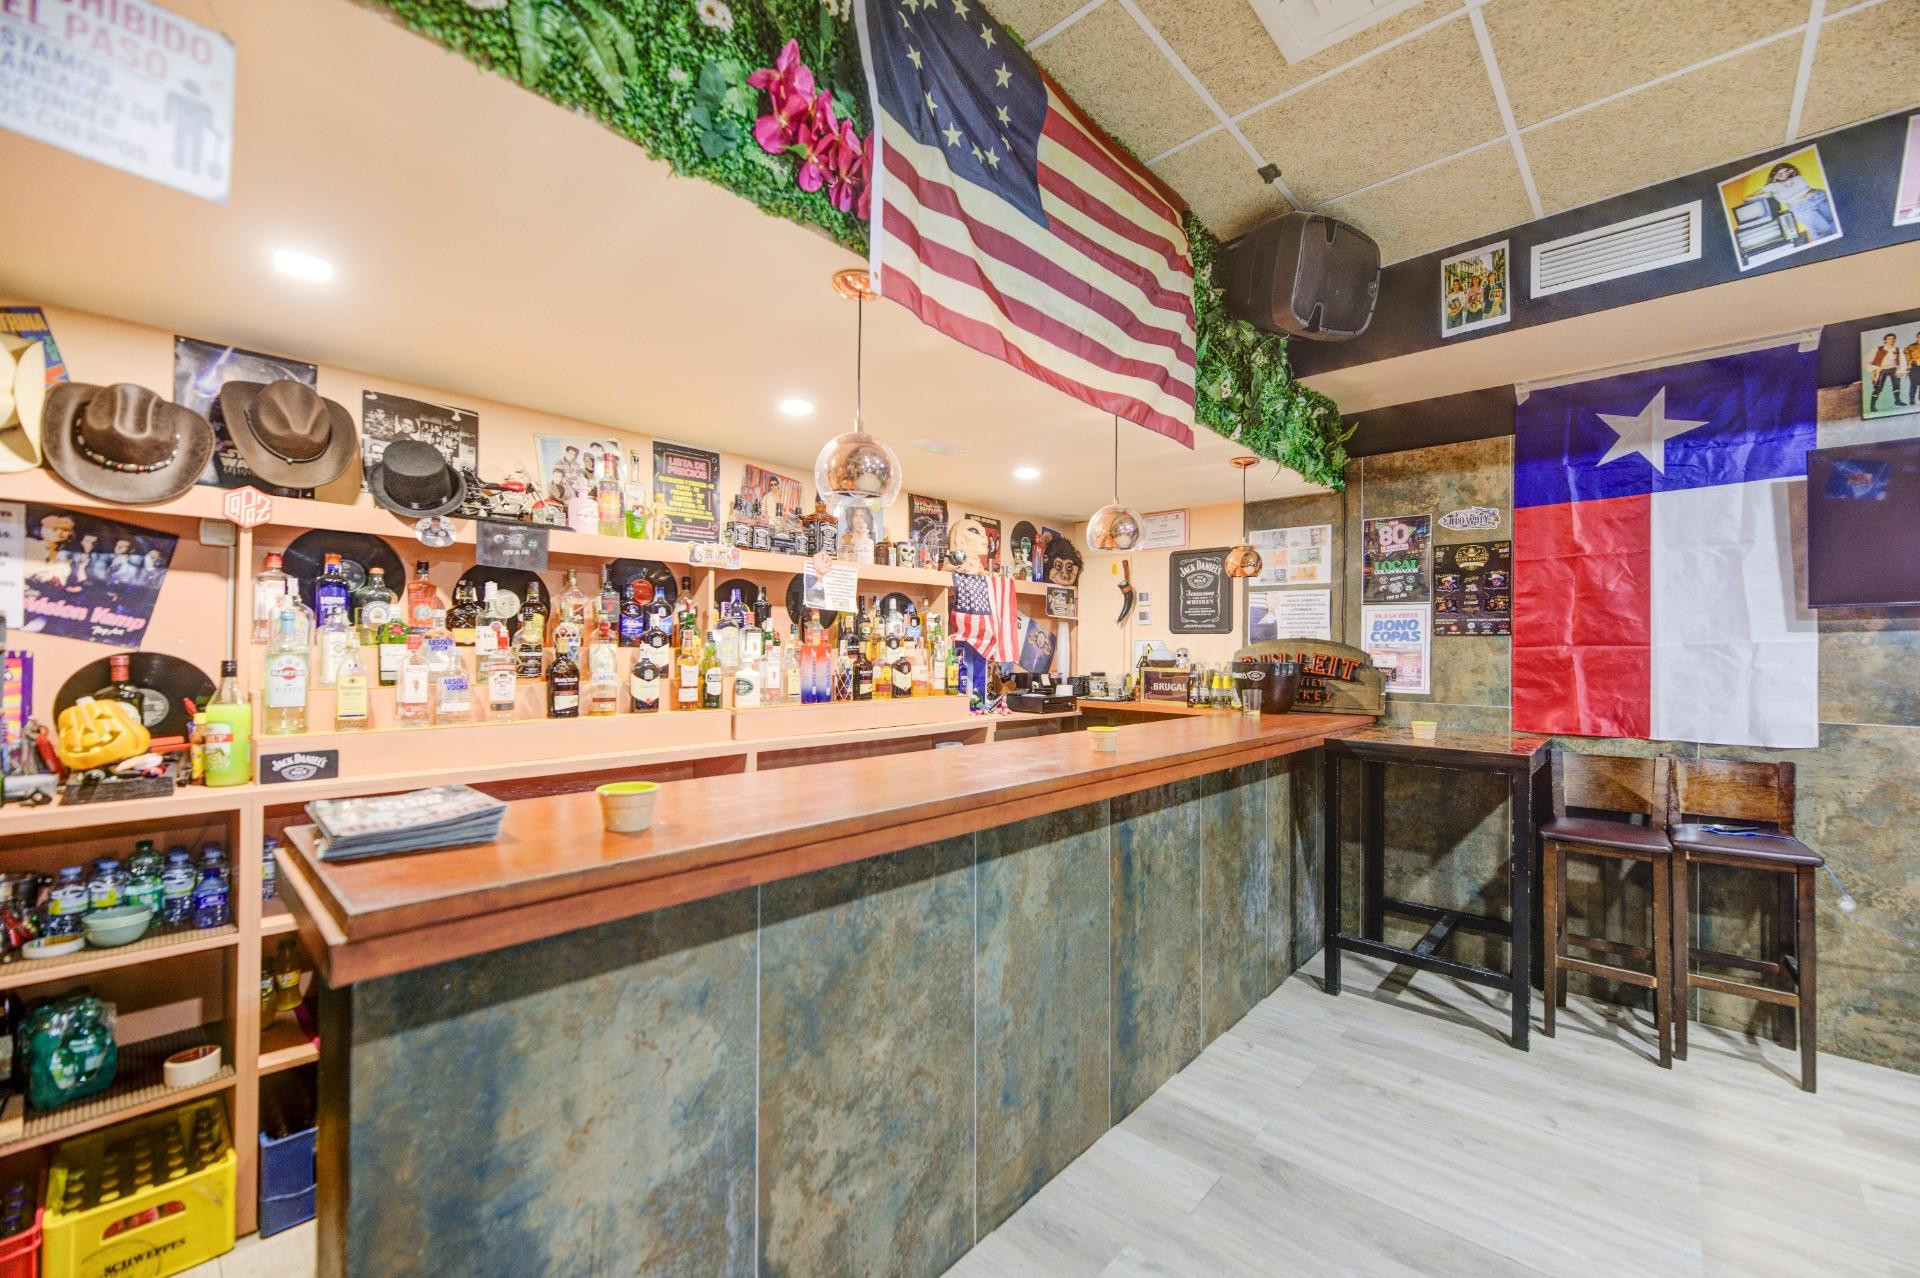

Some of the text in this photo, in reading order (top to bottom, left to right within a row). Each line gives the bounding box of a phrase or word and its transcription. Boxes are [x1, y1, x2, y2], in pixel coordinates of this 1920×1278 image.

[62, 0, 212, 67] HIBIDO
[64, 12, 169, 80] PASO
[0, 24, 112, 86] STAMOS
[1180, 562, 1196, 577] JACK
[1370, 631, 1421, 642] COPAS
[1373, 620, 1419, 632] BONO
[1153, 682, 1187, 692] BRUGAL
[103, 1237, 187, 1275] SCHWEPPES
